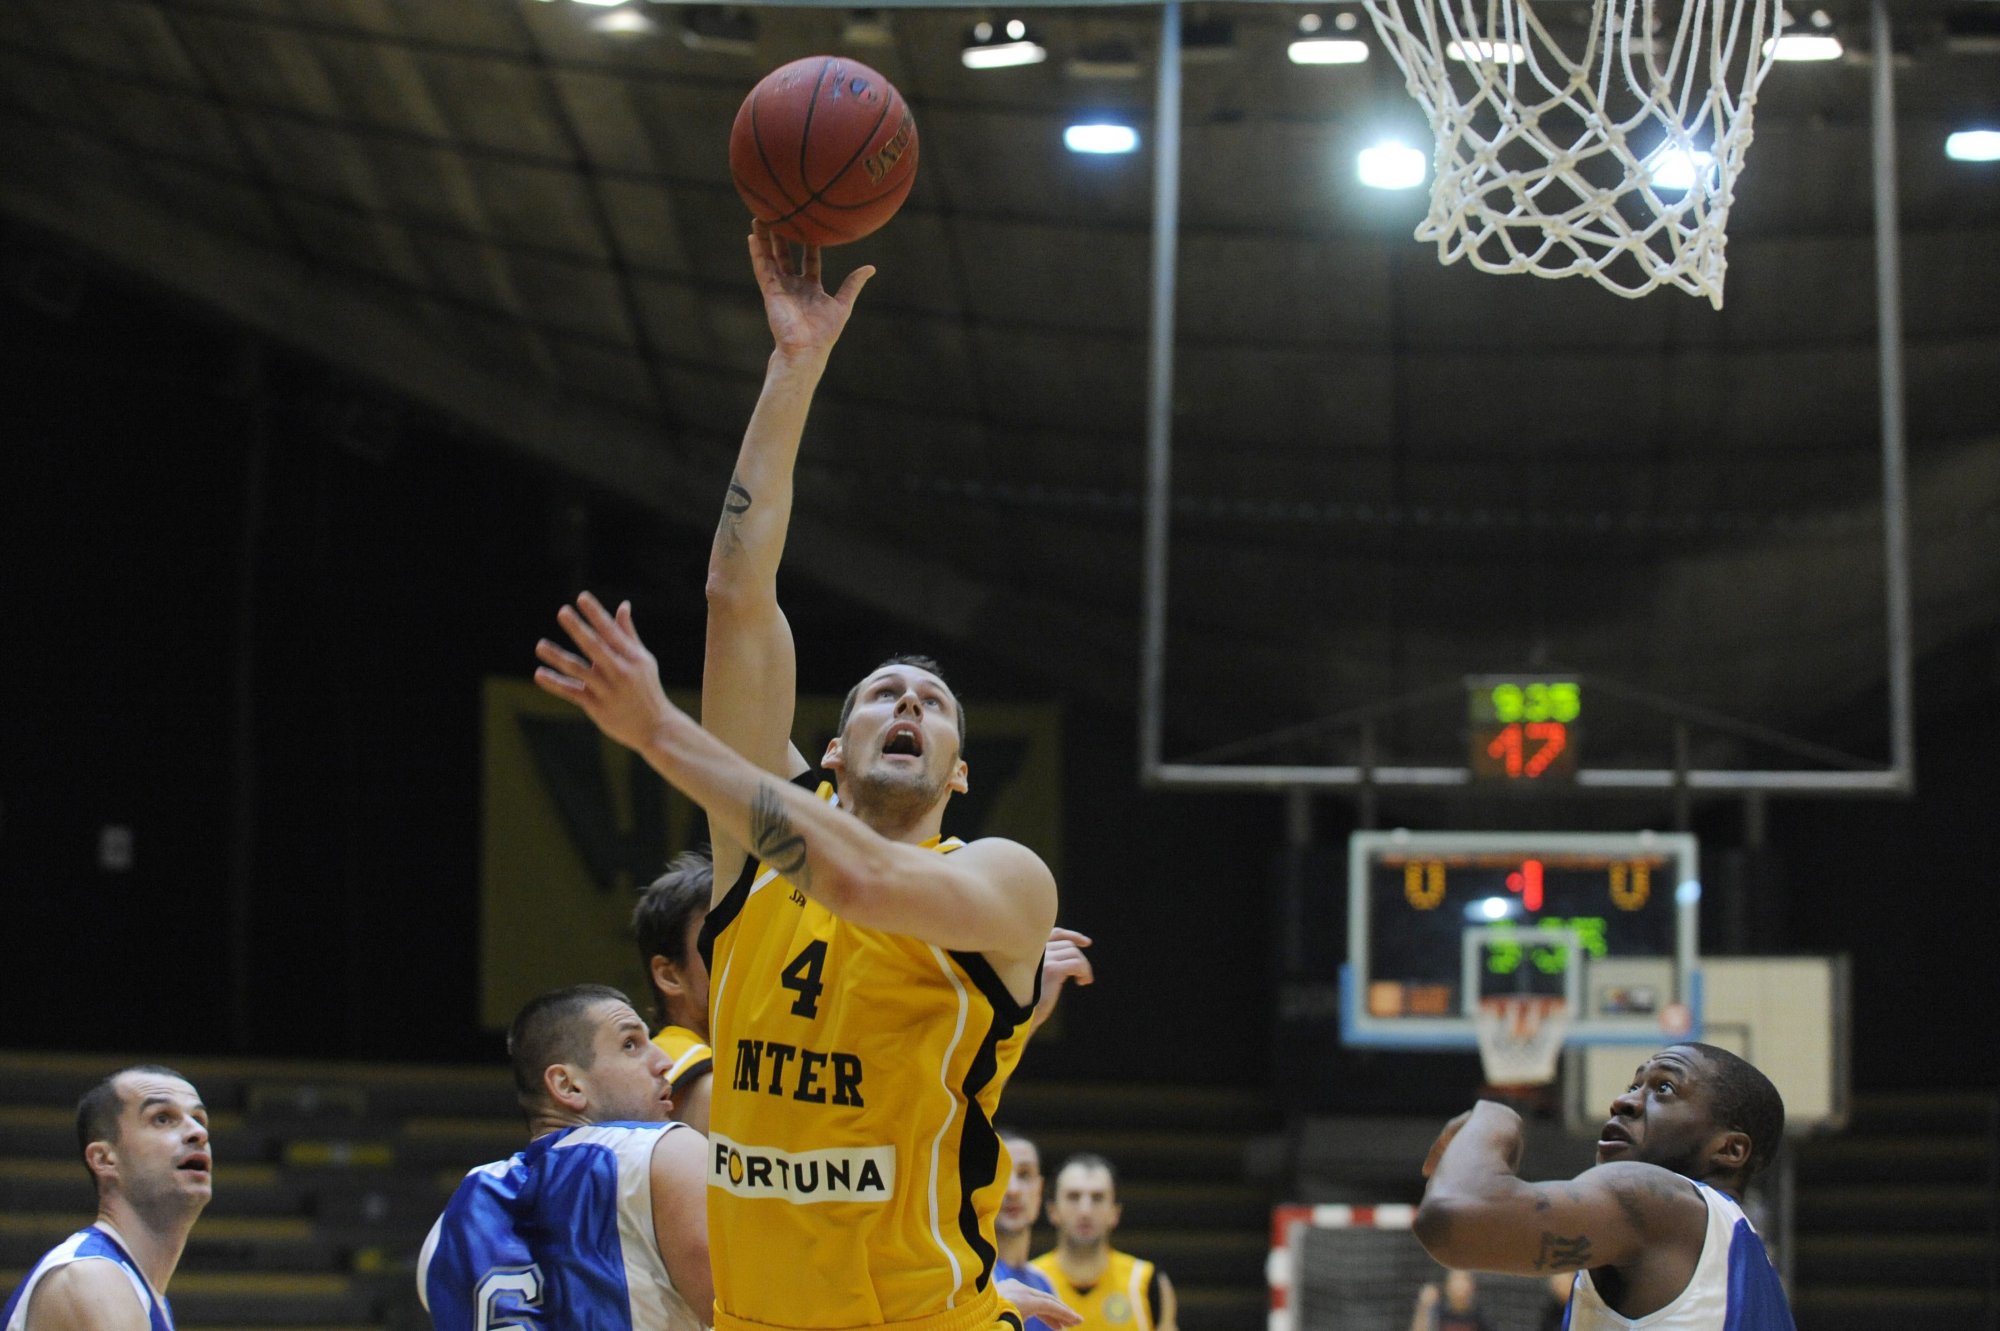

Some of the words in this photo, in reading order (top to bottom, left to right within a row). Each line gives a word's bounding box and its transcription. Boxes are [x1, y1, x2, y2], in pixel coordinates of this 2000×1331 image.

[1488, 722, 1566, 778] 17
[781, 938, 828, 1020] 4
[714, 1143, 886, 1194] FORTUNA
